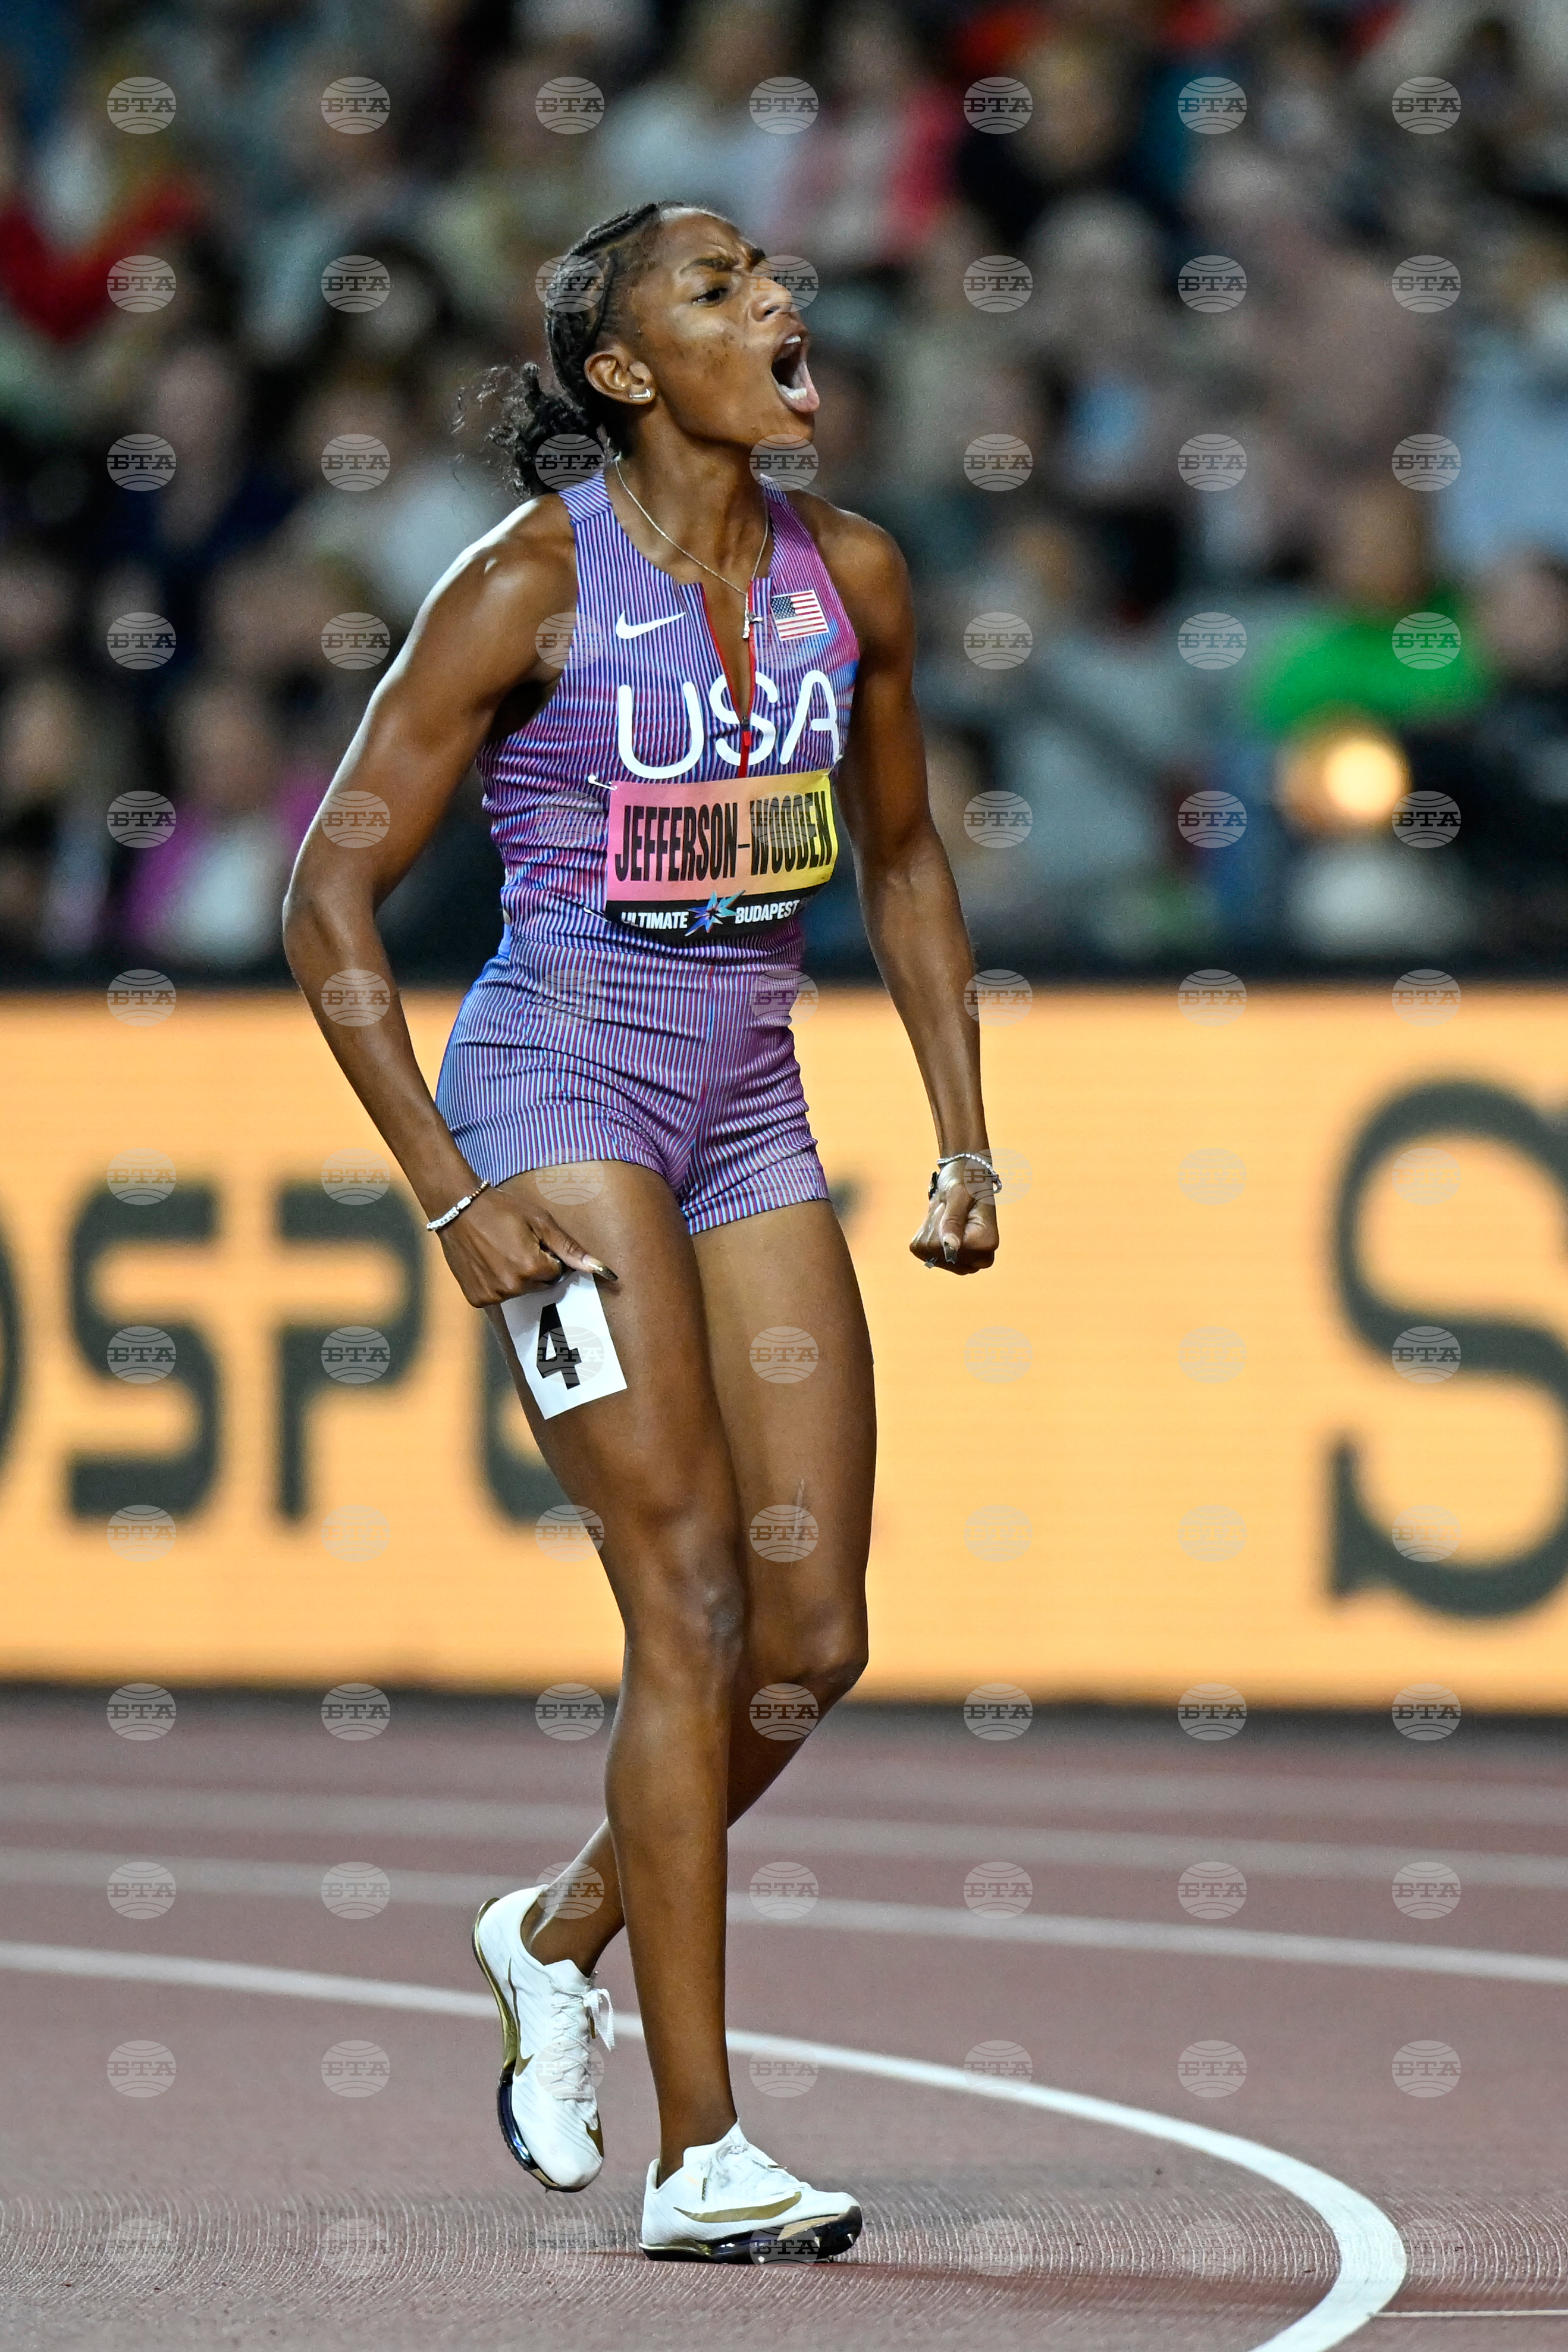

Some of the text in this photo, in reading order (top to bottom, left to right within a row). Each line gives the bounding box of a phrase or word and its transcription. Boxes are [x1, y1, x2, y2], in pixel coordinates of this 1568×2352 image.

[617, 669, 841, 779] USA
[615, 790, 833, 882] JEFFERSON-WOODEN
[621, 912, 689, 929] ULTIMATE
[735, 899, 801, 924] BUDAPEST
[537, 1302, 582, 1390] 4
